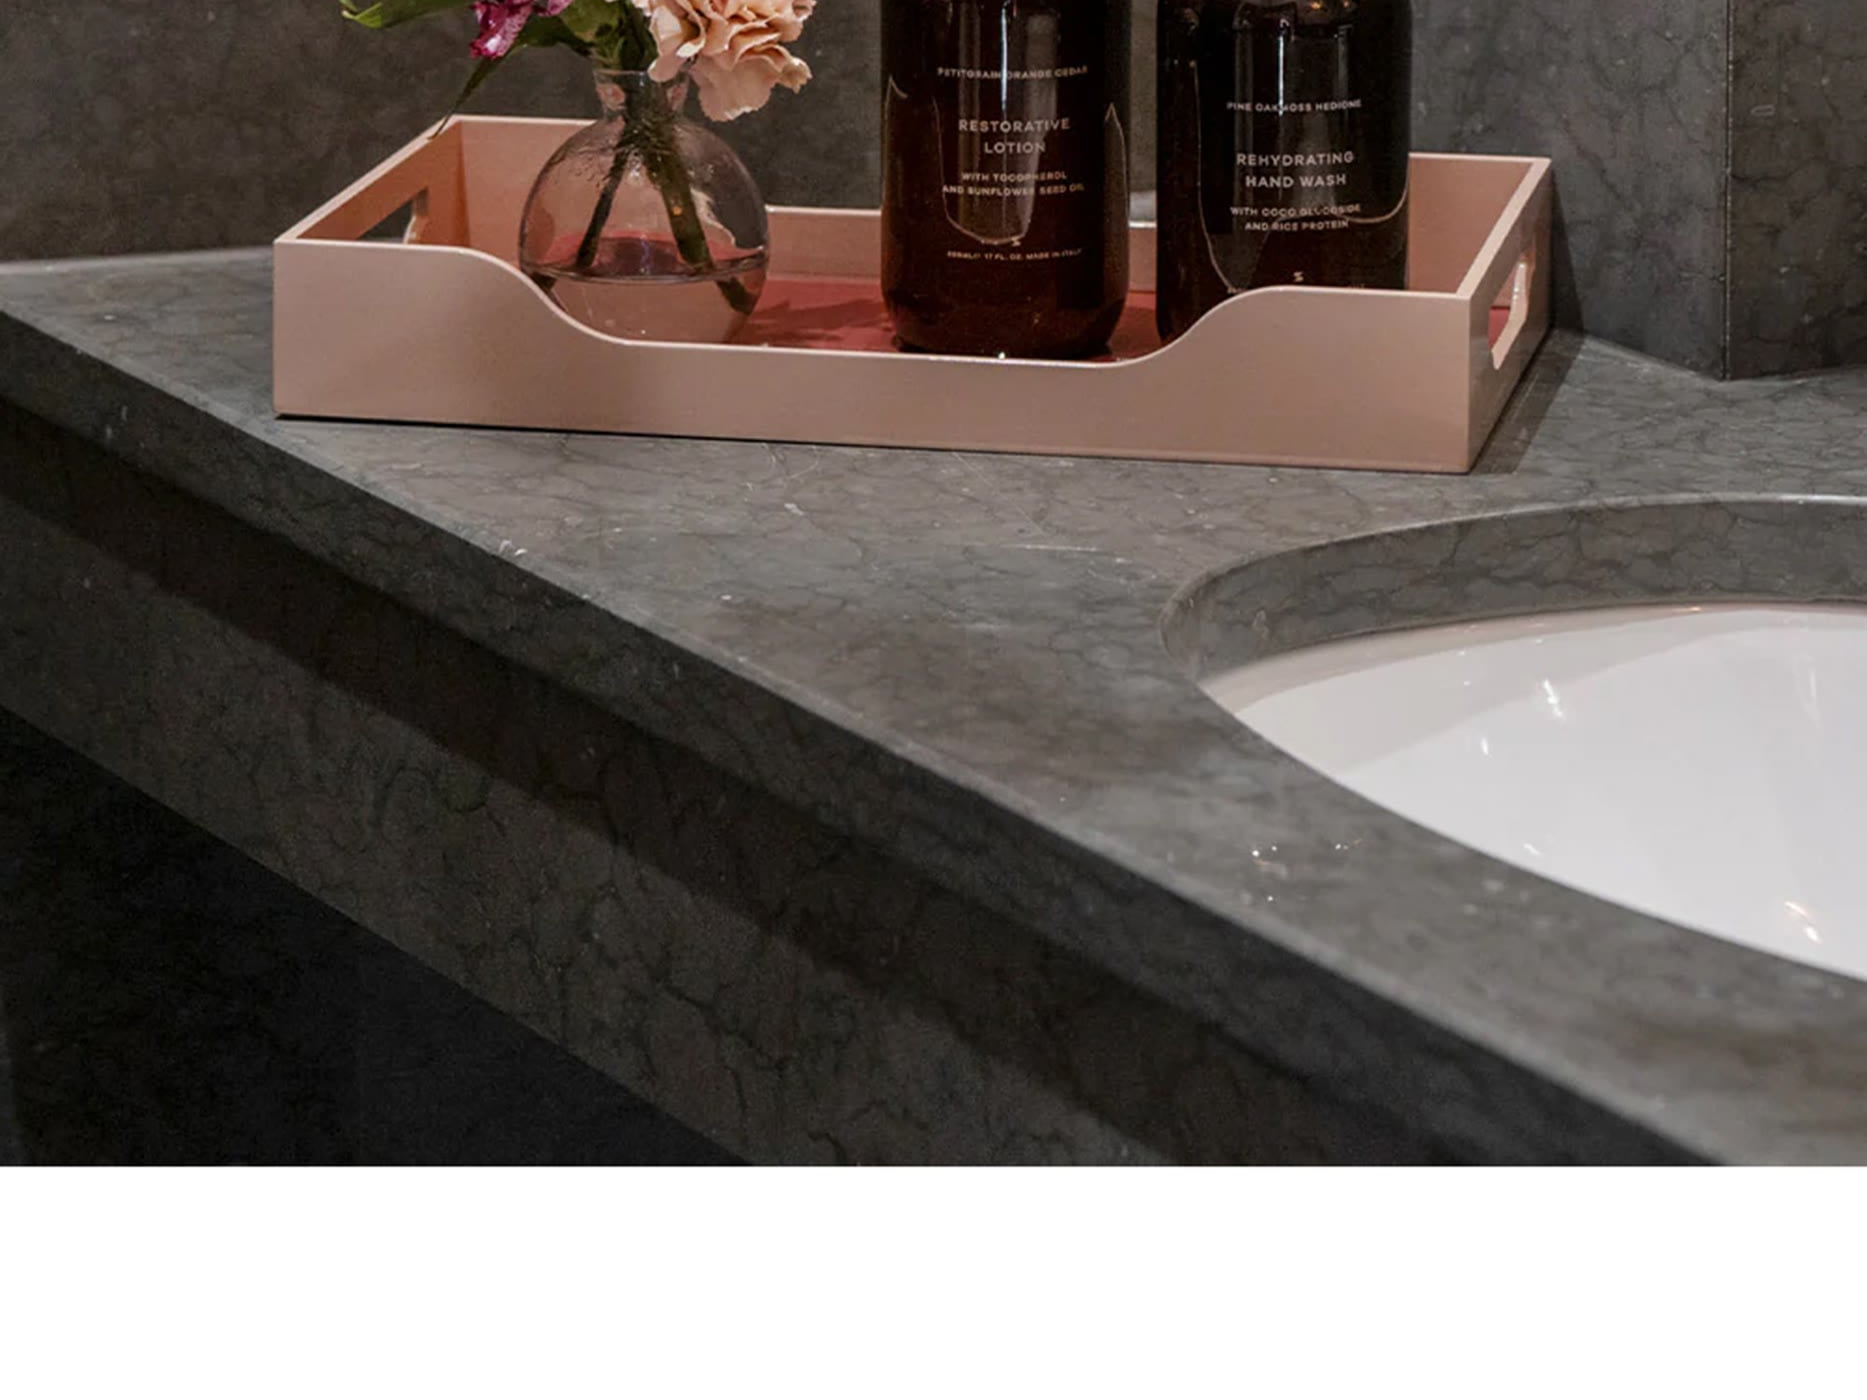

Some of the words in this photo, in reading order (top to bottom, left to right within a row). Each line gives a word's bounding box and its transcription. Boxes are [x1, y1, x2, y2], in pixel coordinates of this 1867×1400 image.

[1226, 102, 1251, 112] PINE
[958, 118, 1070, 133] RESTORATIVE
[984, 142, 1045, 154] LOTION
[1236, 151, 1354, 166] REHYDRATING
[961, 172, 989, 181] WITH
[1245, 176, 1294, 188] HAND
[1300, 174, 1346, 187] WASH
[942, 185, 964, 194] AND
[1039, 185, 1066, 195] SEED
[1230, 206, 1258, 216] WITH
[1261, 207, 1297, 217] COCO
[1245, 222, 1268, 231] AND
[1271, 222, 1298, 231] RICE
[1301, 220, 1349, 231] PROTEIN
